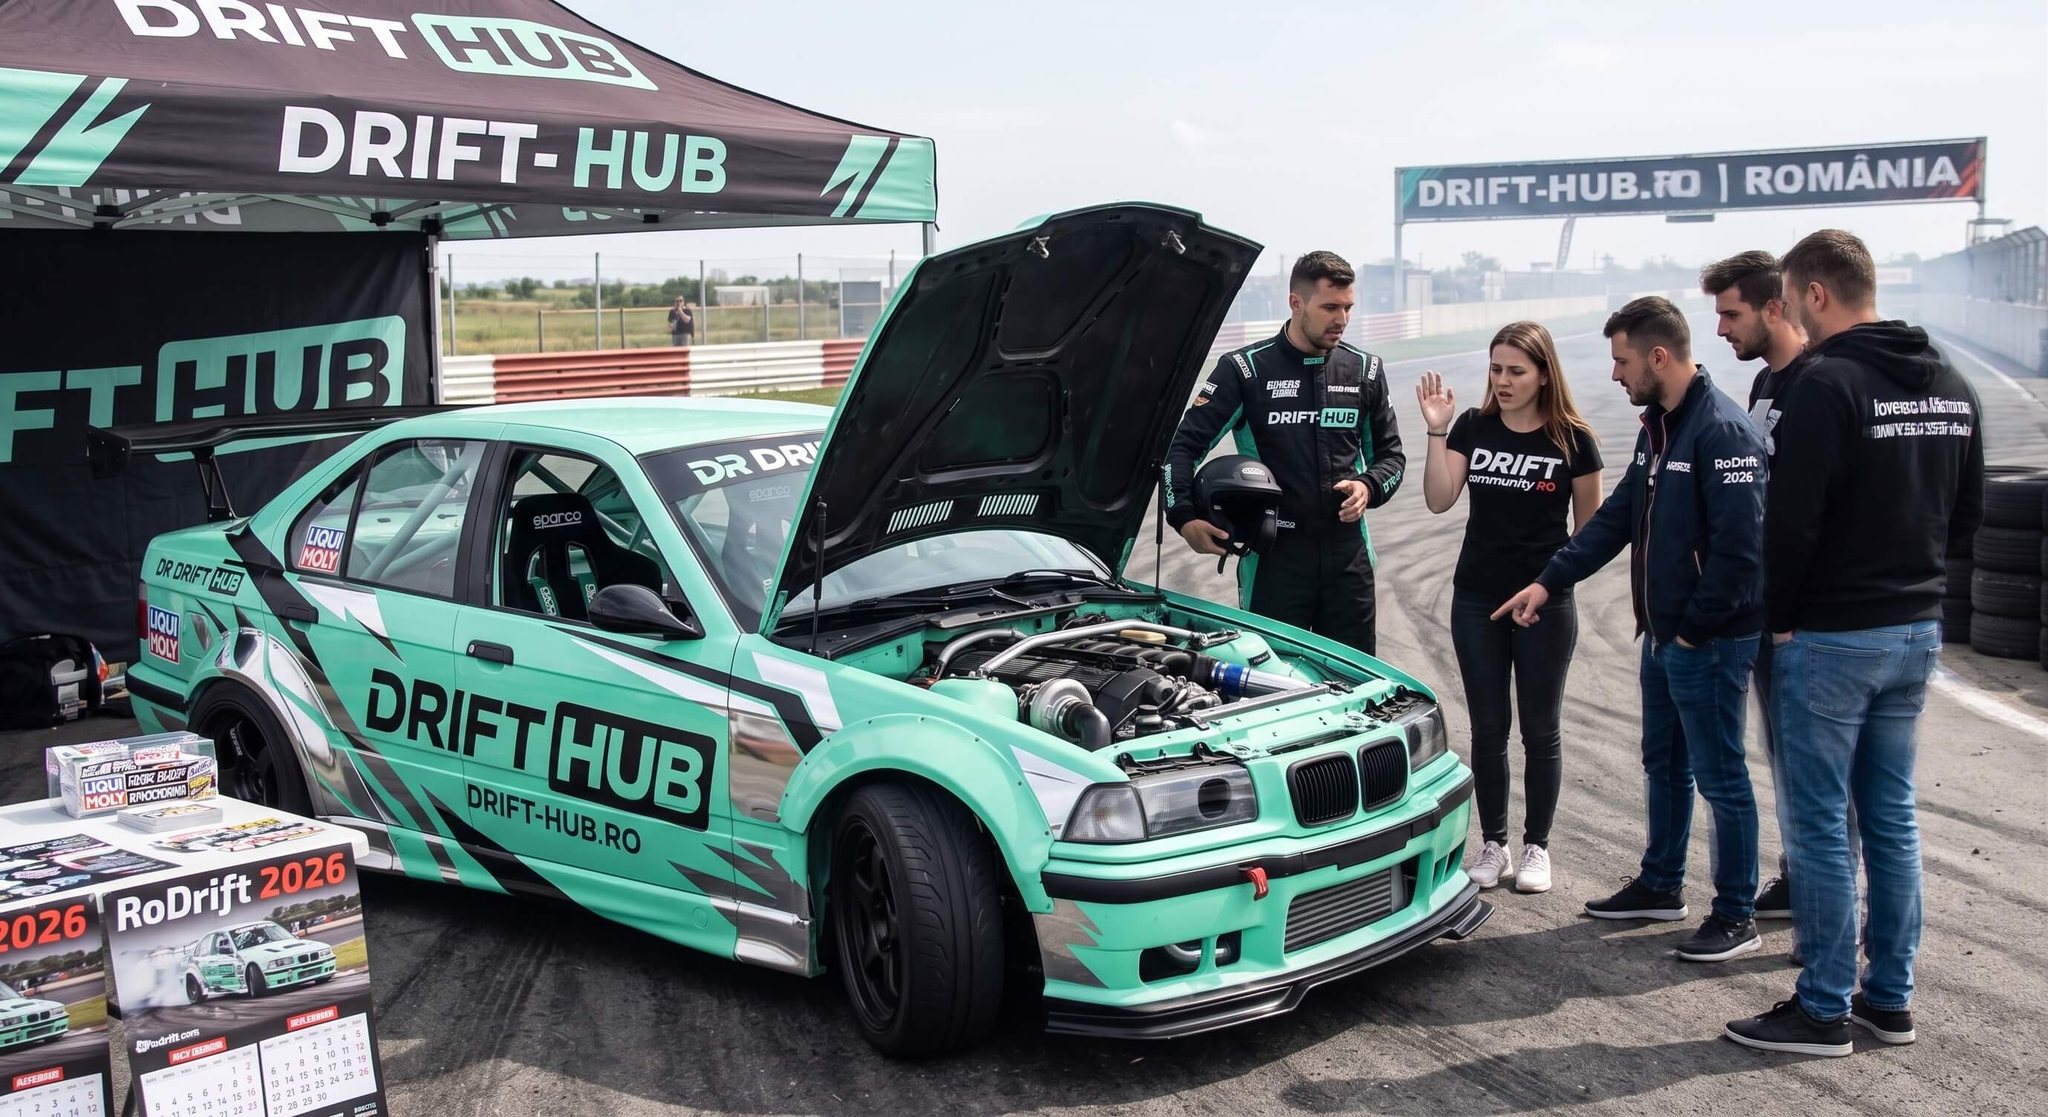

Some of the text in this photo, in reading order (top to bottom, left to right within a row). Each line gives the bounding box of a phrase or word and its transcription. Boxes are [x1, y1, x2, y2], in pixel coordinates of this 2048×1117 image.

[427, 26, 634, 79] HUB
[1745, 153, 1962, 195] ROMÂNIA
[1469, 448, 1564, 481] DRIFT
[1714, 456, 1758, 470] RoDrift
[1468, 474, 1556, 492] community RO
[1723, 472, 1754, 484] 2026
[307, 528, 345, 550] LIQUI
[300, 550, 340, 571] MOLY
[156, 558, 241, 592] DR DRIFT HUB
[150, 608, 178, 637] LIQUI
[150, 633, 178, 663] MOLY
[365, 667, 704, 814] DRIFT HUB
[84, 778, 123, 795] LIQUI
[86, 792, 126, 810] MOLY
[467, 783, 642, 854] DRIFT-HUB.RO
[117, 852, 346, 932] RoDrift 2026
[271, 1067, 276, 1075] 6
[326, 1050, 335, 1059] 10
[342, 1046, 349, 1054] 11
[356, 1042, 365, 1051] 12
[271, 1080, 279, 1089] 13
[285, 1075, 294, 1084] 14
[299, 1071, 308, 1080] 15
[314, 1067, 323, 1075] 16
[328, 1063, 336, 1071] 17
[343, 1059, 351, 1067] 18
[300, 1084, 310, 1093] 22
[330, 1076, 339, 1085] 24
[344, 1072, 354, 1081] 25
[202, 1088, 208, 1097] 6
[233, 1080, 238, 1088] 8
[34, 1103, 40, 1112] 2
[52, 1099, 58, 1108] 3
[88, 1091, 94, 1099] 5
[187, 1106, 196, 1115] 12
[203, 1101, 213, 1111] 13
[217, 1097, 227, 1106] 14
[233, 1092, 242, 1102] 15
[234, 1106, 243, 1115] 22
[273, 1105, 283, 1115] 27
[303, 1097, 312, 1106] 29
[317, 1092, 327, 1102] 30
